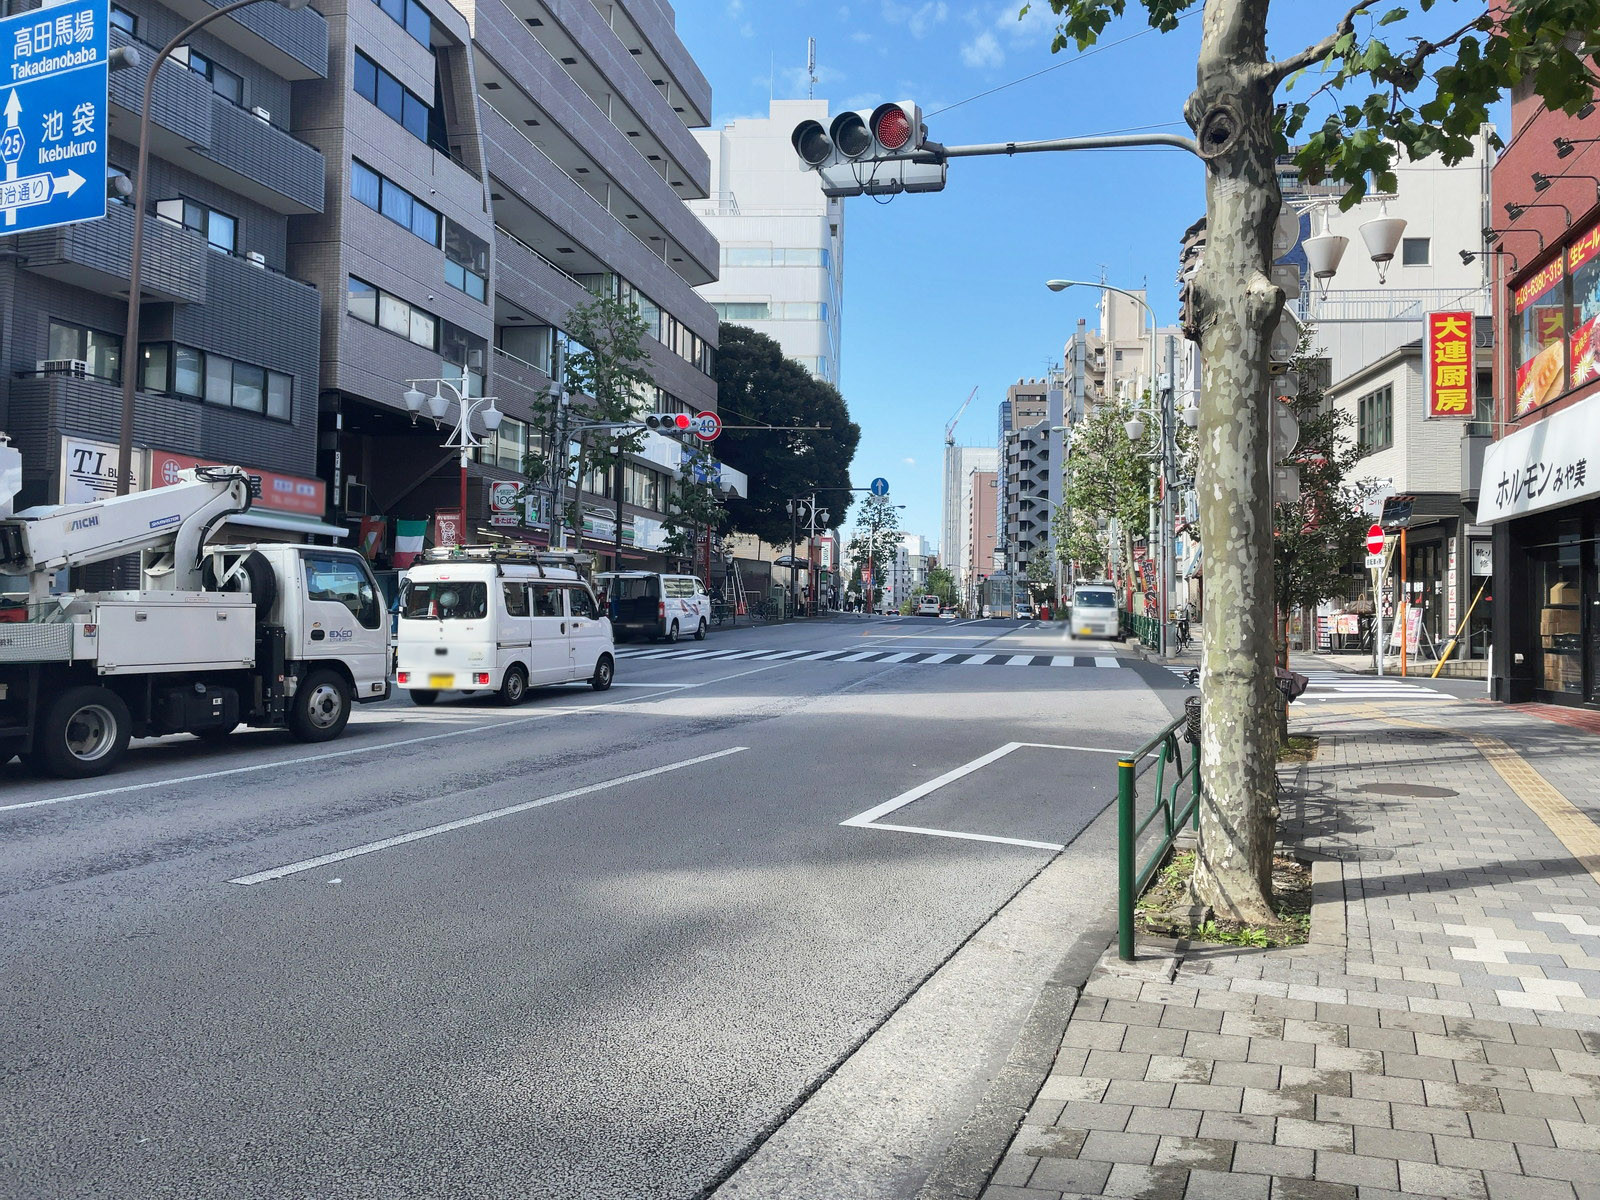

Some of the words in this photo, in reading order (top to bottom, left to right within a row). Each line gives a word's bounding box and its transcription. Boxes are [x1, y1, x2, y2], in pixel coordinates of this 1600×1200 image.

[13, 9, 95, 60] 高田馬場
[10, 46, 97, 80] Takadanobaba
[41, 102, 95, 143] 池袋
[4, 133, 21, 156] 25
[38, 140, 97, 164] Ikebukuro
[1434, 316, 1468, 412] 大連厨房
[700, 419, 715, 433] 40
[1495, 462, 1553, 510] ホルモン
[1552, 457, 1587, 492] みや美
[329, 627, 352, 637] EXEO
